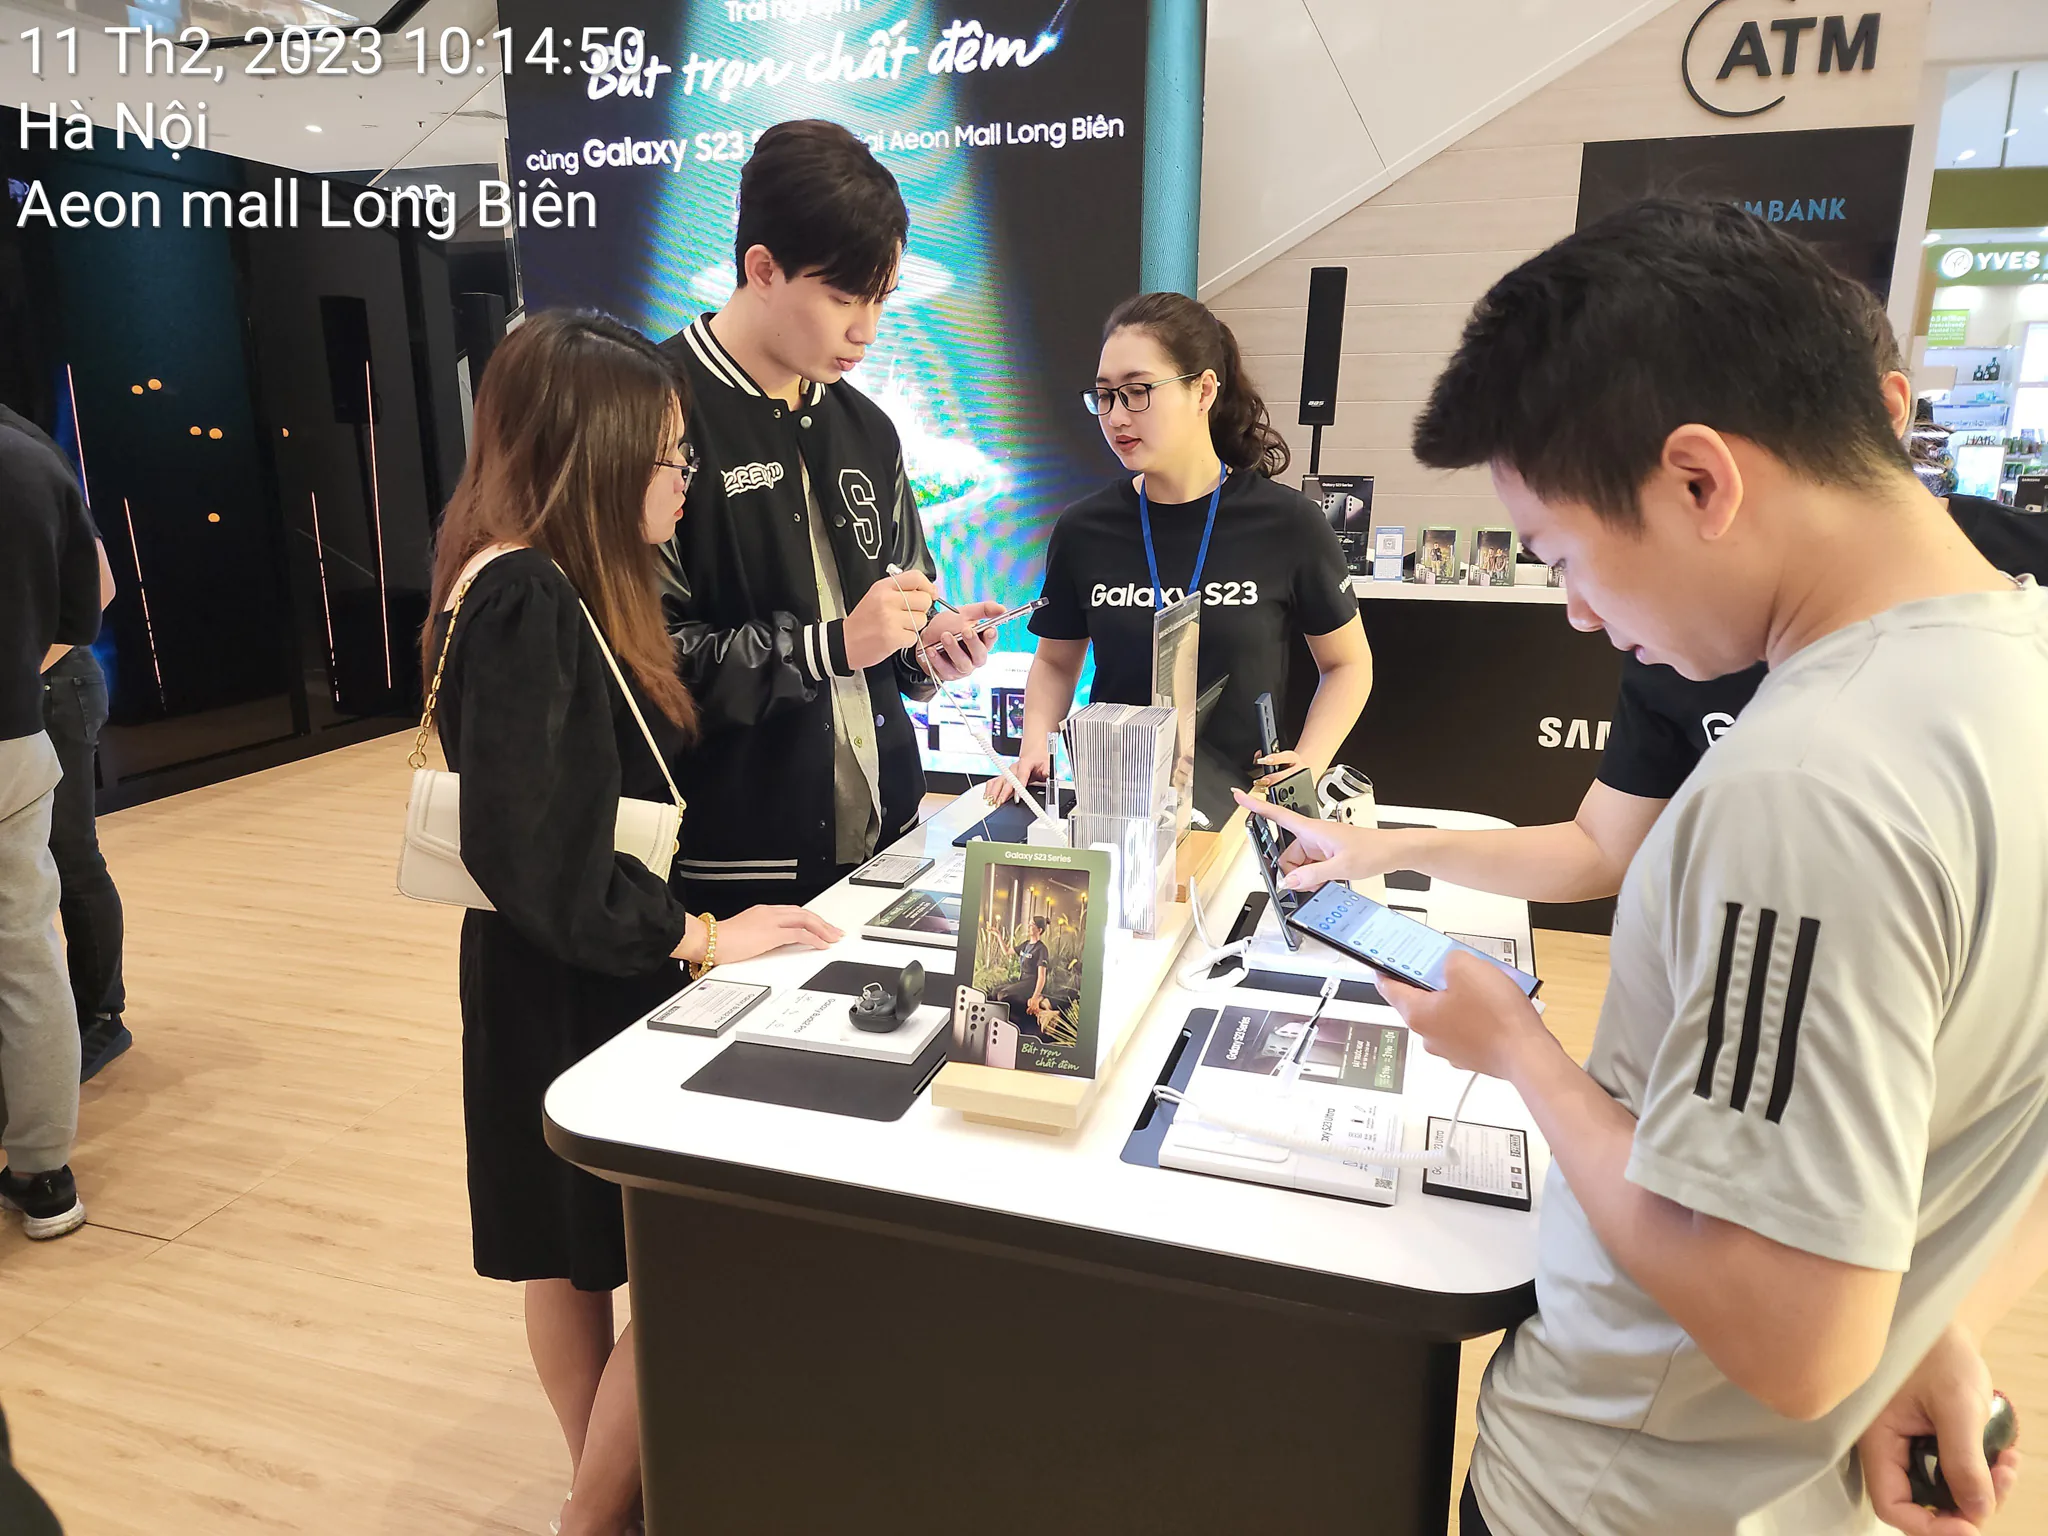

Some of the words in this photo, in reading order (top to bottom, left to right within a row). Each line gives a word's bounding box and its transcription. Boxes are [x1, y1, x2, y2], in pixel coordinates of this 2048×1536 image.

[1715, 13, 1882, 80] ATM
[682, 52, 794, 101] trọn
[804, 19, 920, 82] chất
[928, 19, 1054, 75] đêm
[889, 129, 950, 151] Aeon
[955, 122, 1001, 147] Mall
[1006, 121, 1067, 149] Long
[1071, 114, 1125, 141] Biên
[526, 149, 580, 176] cùng
[582, 136, 688, 173] Galaxy
[694, 130, 745, 162] S23
[1733, 197, 1847, 222] MBANK
[1976, 250, 2042, 271] YVES
[838, 469, 883, 560] S
[1203, 580, 1259, 607] S23
[1004, 850, 1033, 862] Galaxy
[1033, 853, 1047, 861] S23
[1047, 854, 1072, 863] Series
[1236, 1016, 1252, 1033] Series
[1021, 1042, 1038, 1054] Bắt
[1233, 1031, 1246, 1042] S23
[1225, 1039, 1245, 1061] Galaxy
[1035, 1057, 1057, 1068] chất
